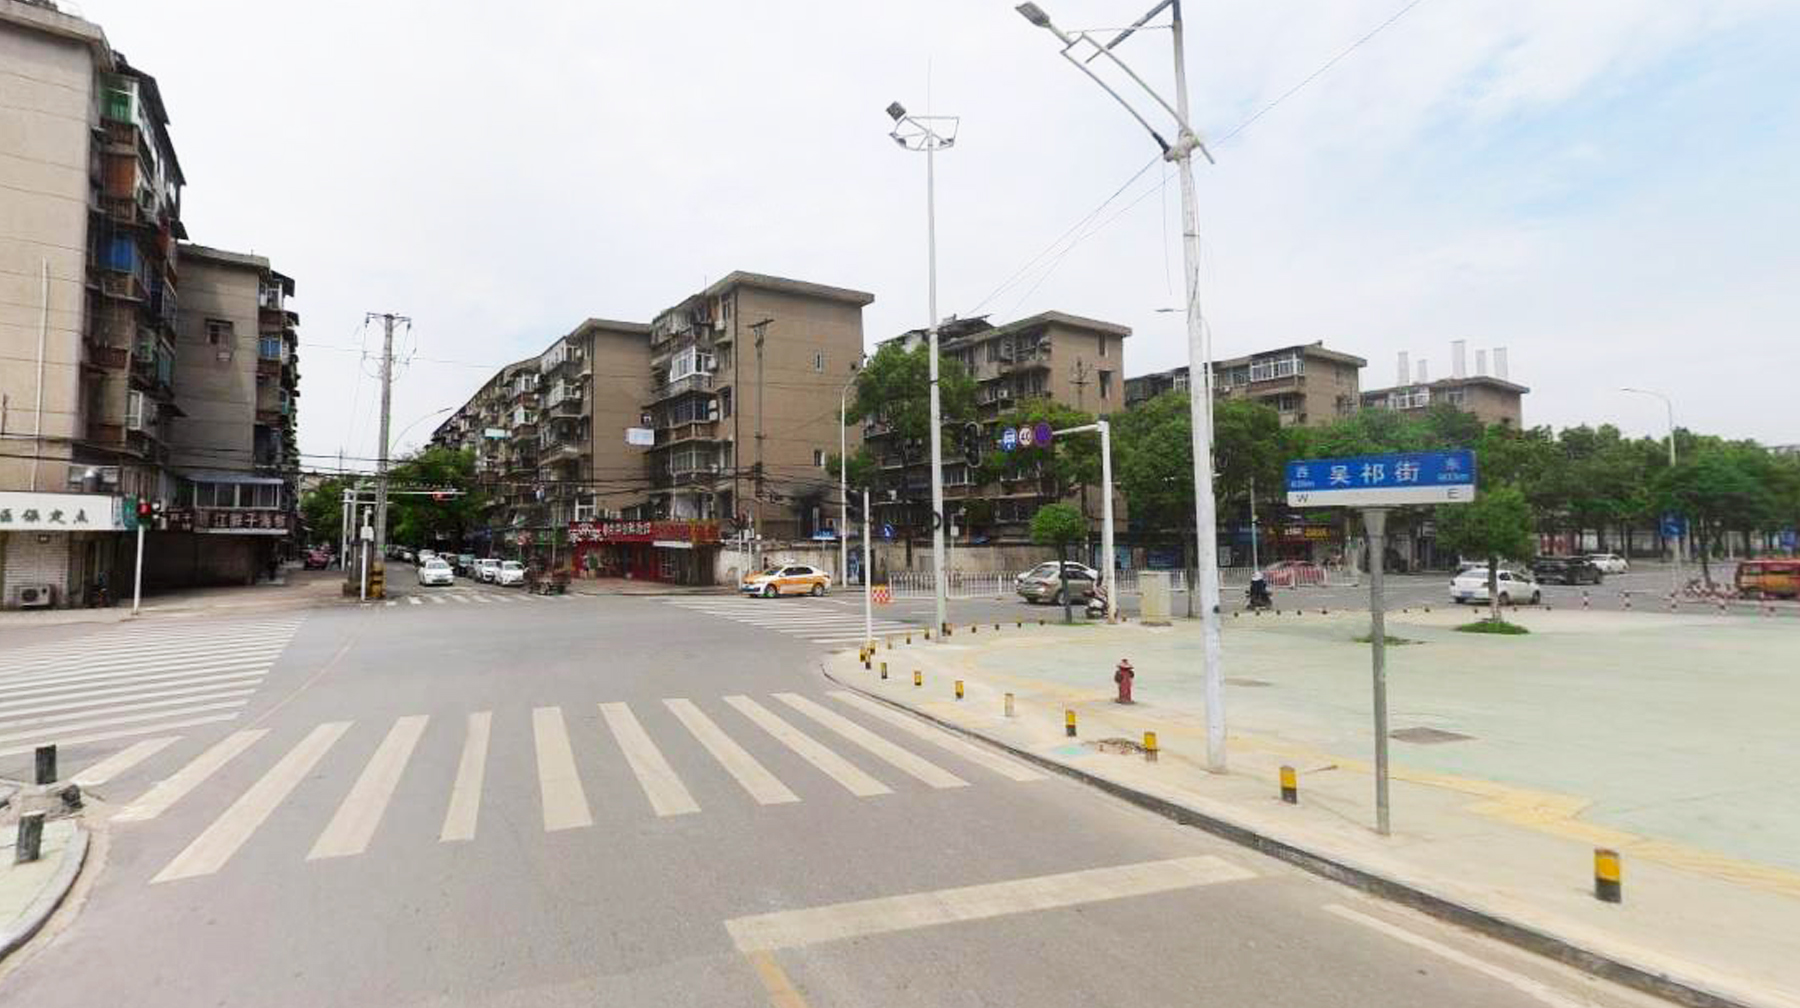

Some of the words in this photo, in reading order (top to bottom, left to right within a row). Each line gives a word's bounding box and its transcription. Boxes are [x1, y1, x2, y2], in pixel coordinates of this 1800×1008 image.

[1329, 461, 1420, 485] 吴祁街
[1296, 493, 1309, 502] W
[1447, 488, 1459, 499] E
